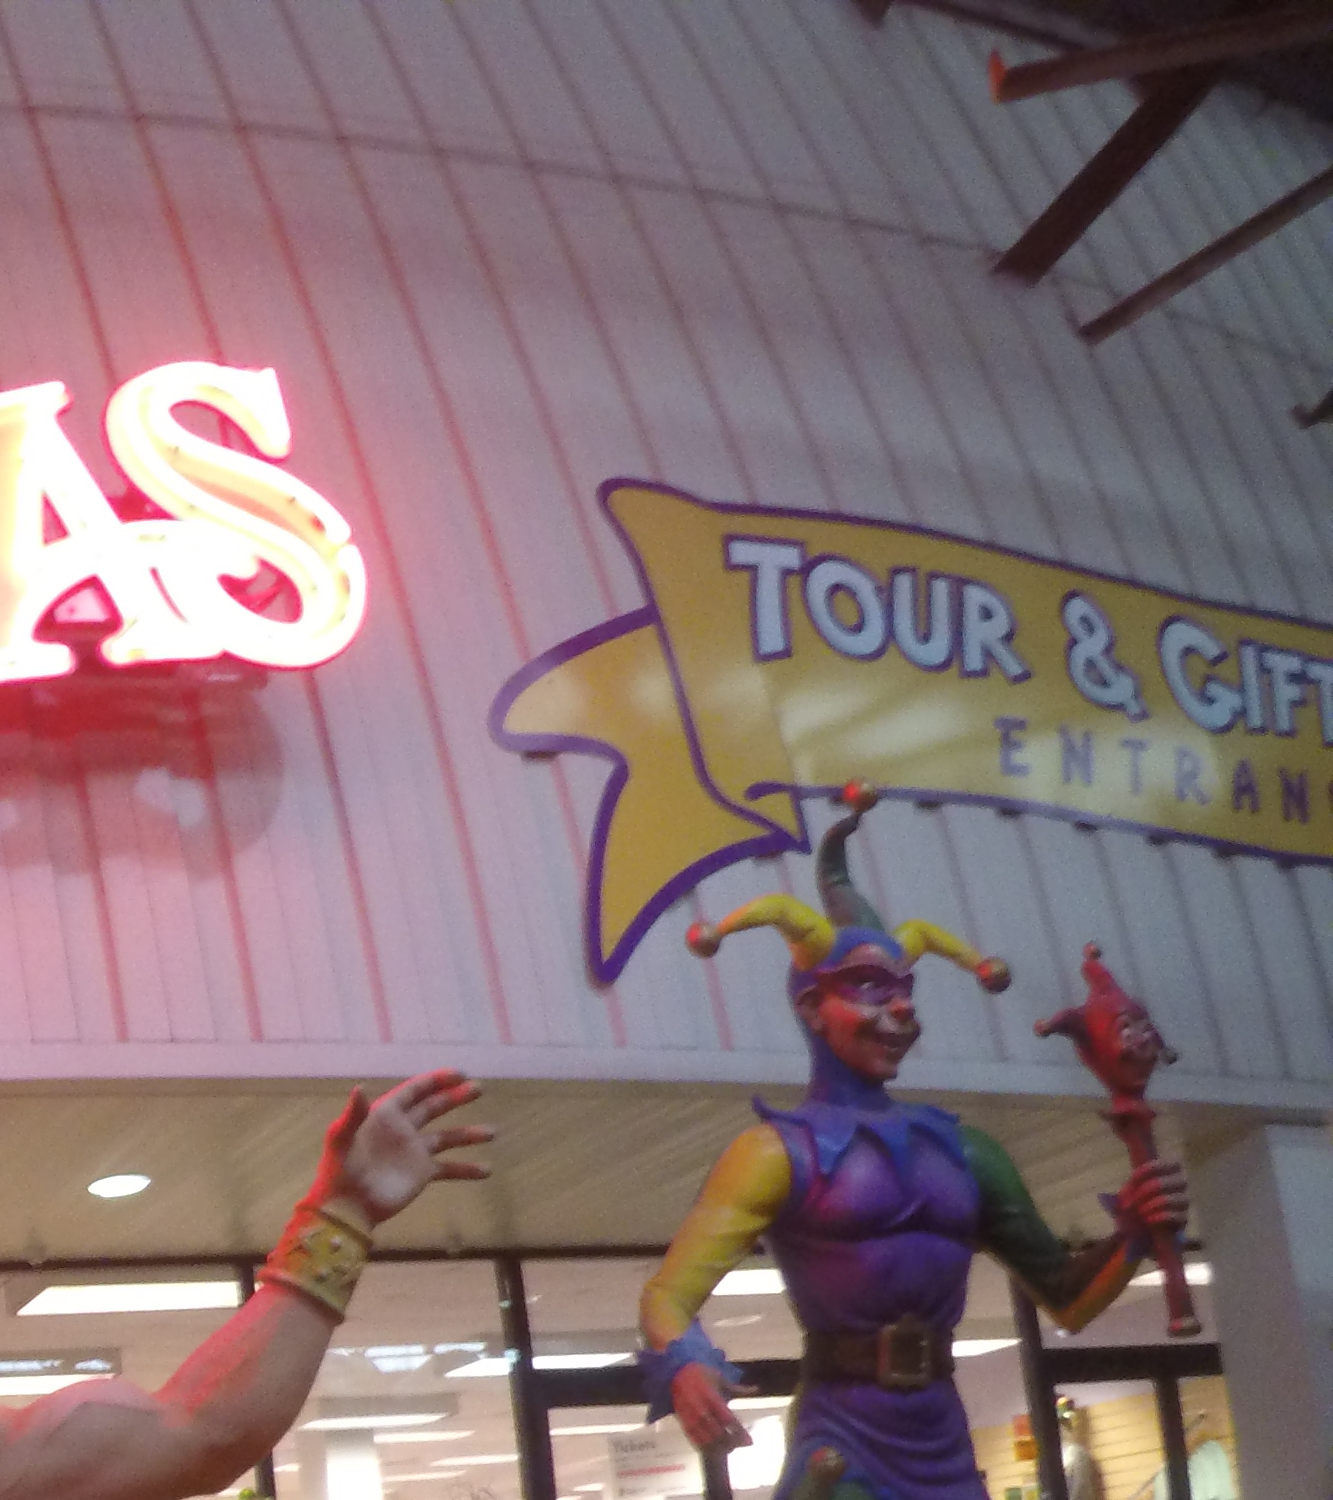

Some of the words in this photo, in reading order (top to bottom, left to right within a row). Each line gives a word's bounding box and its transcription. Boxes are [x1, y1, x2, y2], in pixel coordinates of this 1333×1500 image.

[721, 533, 1033, 685] TOUR
[1061, 590, 1150, 723] &
[993, 713, 1333, 826] ENTRAN
